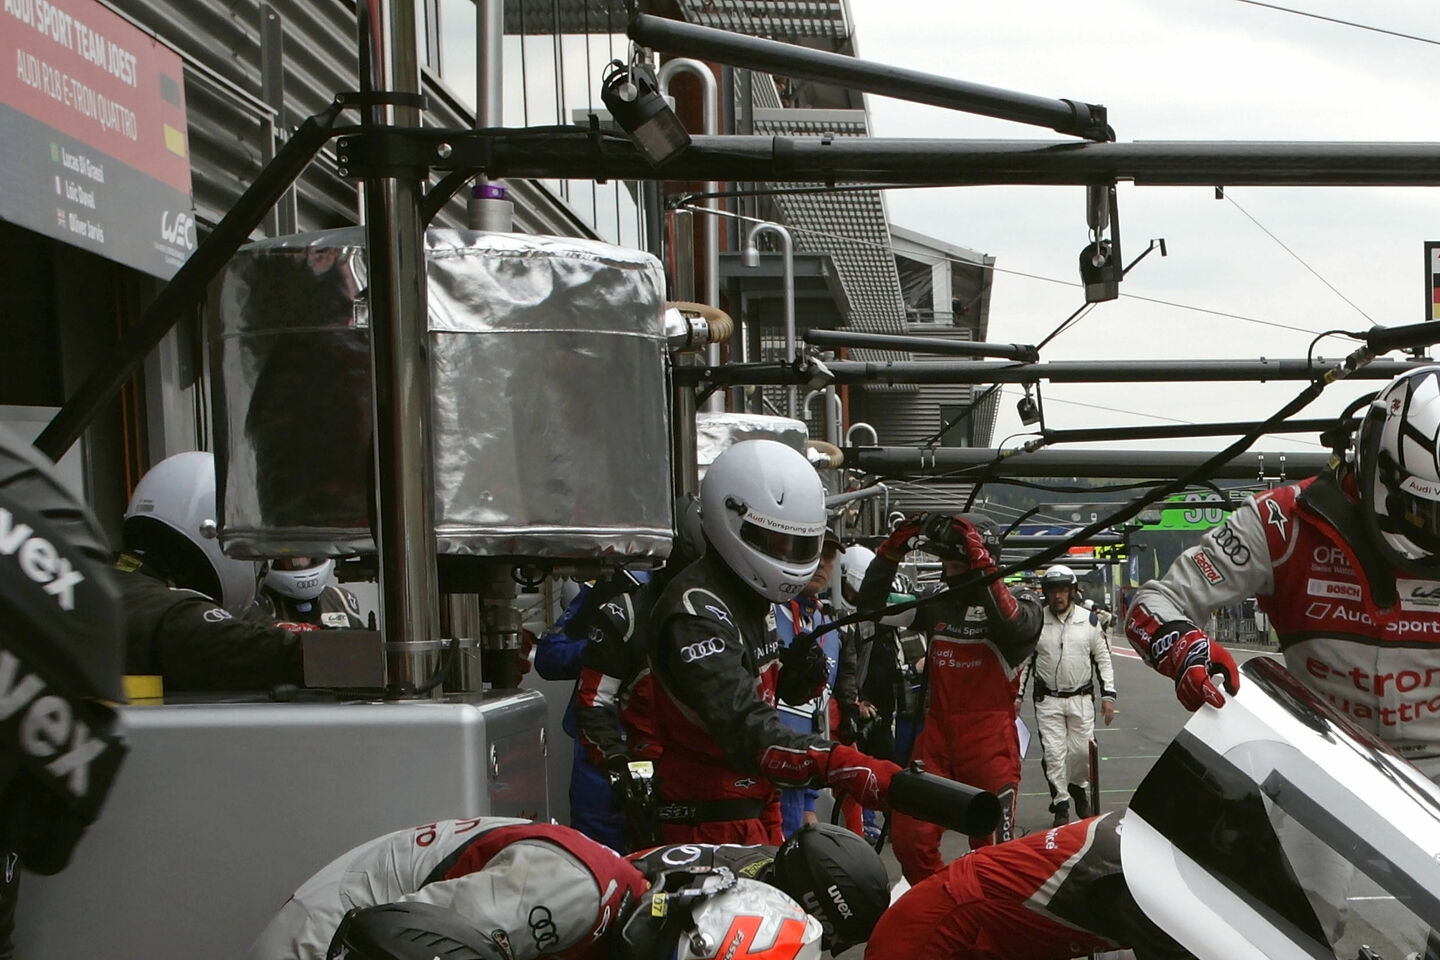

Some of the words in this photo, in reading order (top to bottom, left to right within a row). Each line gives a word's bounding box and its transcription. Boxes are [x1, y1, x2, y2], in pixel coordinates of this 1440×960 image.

[74, 20, 107, 70] TEAM
[108, 41, 137, 88] JOEST
[17, 49, 42, 91] AUDI
[42, 62, 61, 102] R18
[62, 74, 97, 120] E-TRON
[98, 94, 137, 141] QUATTRO
[161, 210, 194, 250] WEC
[1410, 481, 1432, 494] Audi
[747, 512, 765, 524] Audi
[767, 519, 807, 533] Vorsprung
[981, 535, 1000, 545] vex
[0, 507, 85, 611] vex
[1194, 552, 1220, 582] Castrol
[1326, 584, 1360, 598] BOSCH
[0, 650, 108, 797] vex
[827, 884, 853, 919] uvex
